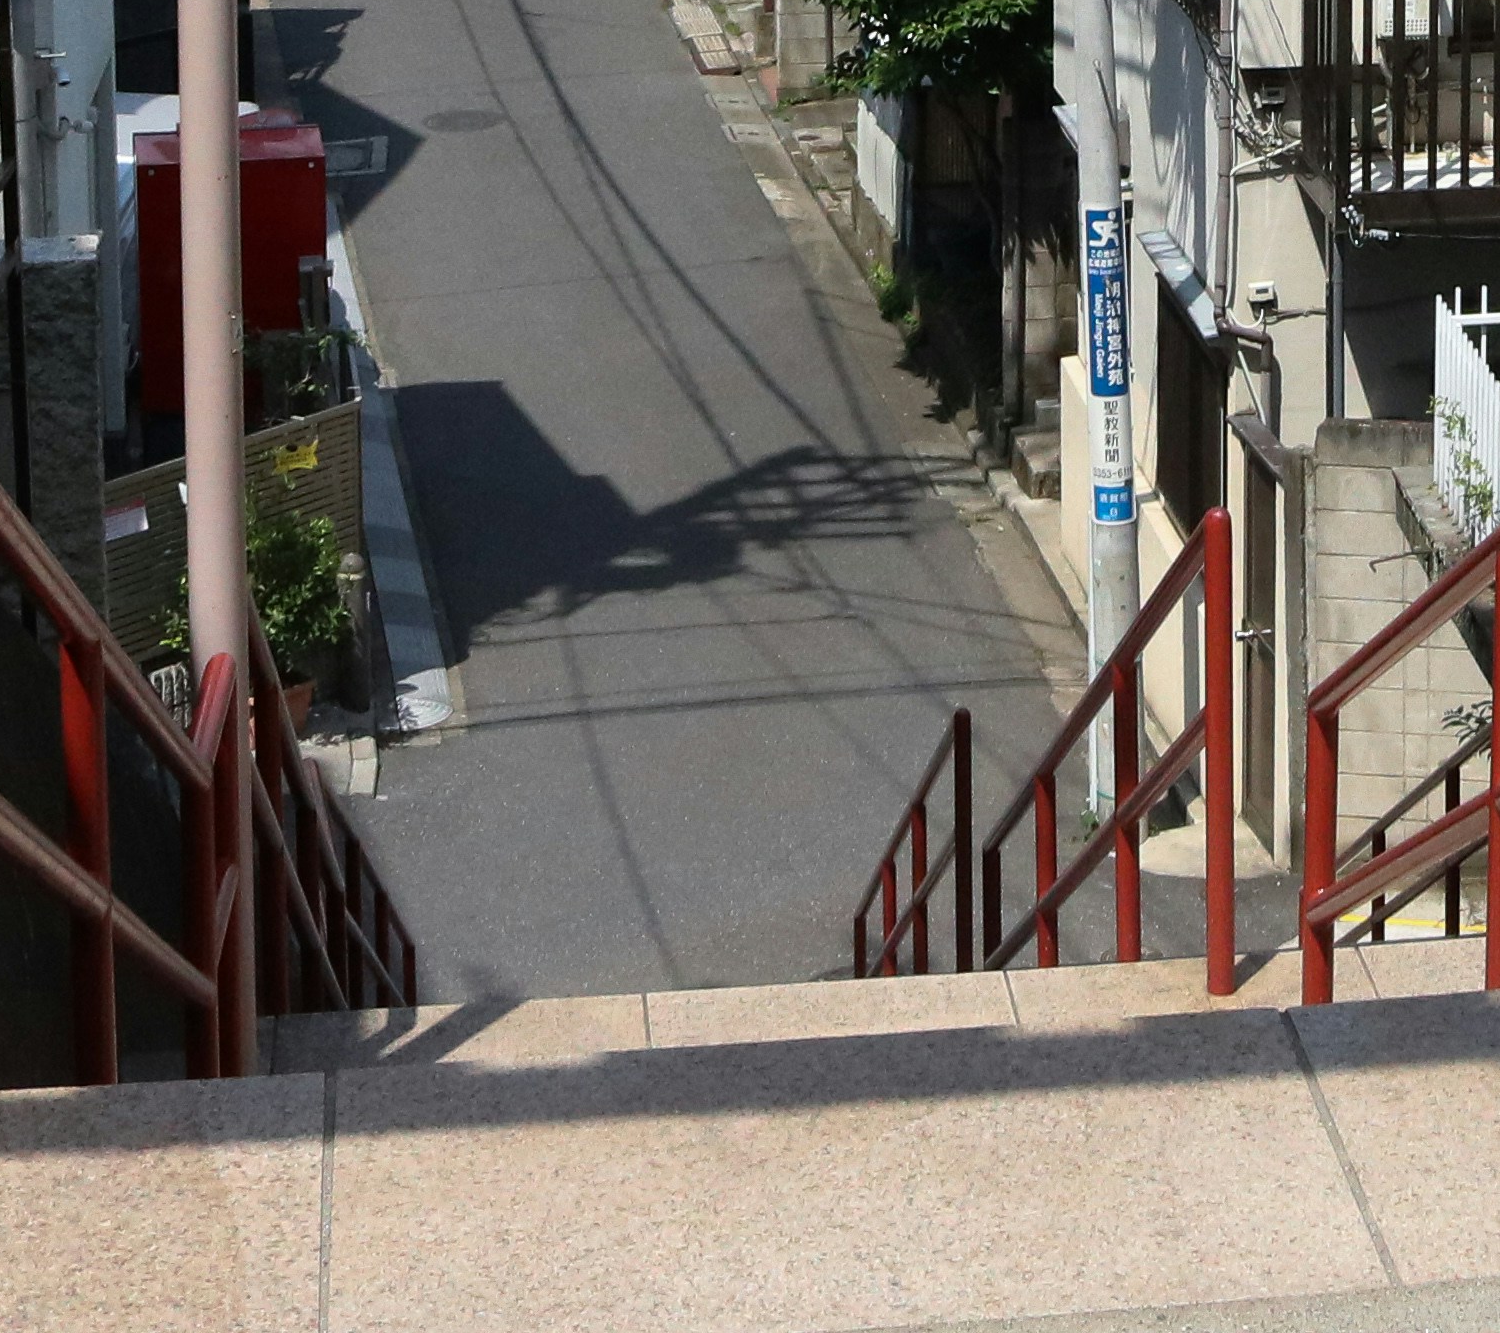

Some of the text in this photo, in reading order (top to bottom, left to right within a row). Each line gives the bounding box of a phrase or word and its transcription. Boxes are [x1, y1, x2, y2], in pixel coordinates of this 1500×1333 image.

[1105, 279, 1124, 386] 明治神宮外苑
[1104, 400, 1120, 463] 聖教新聞
